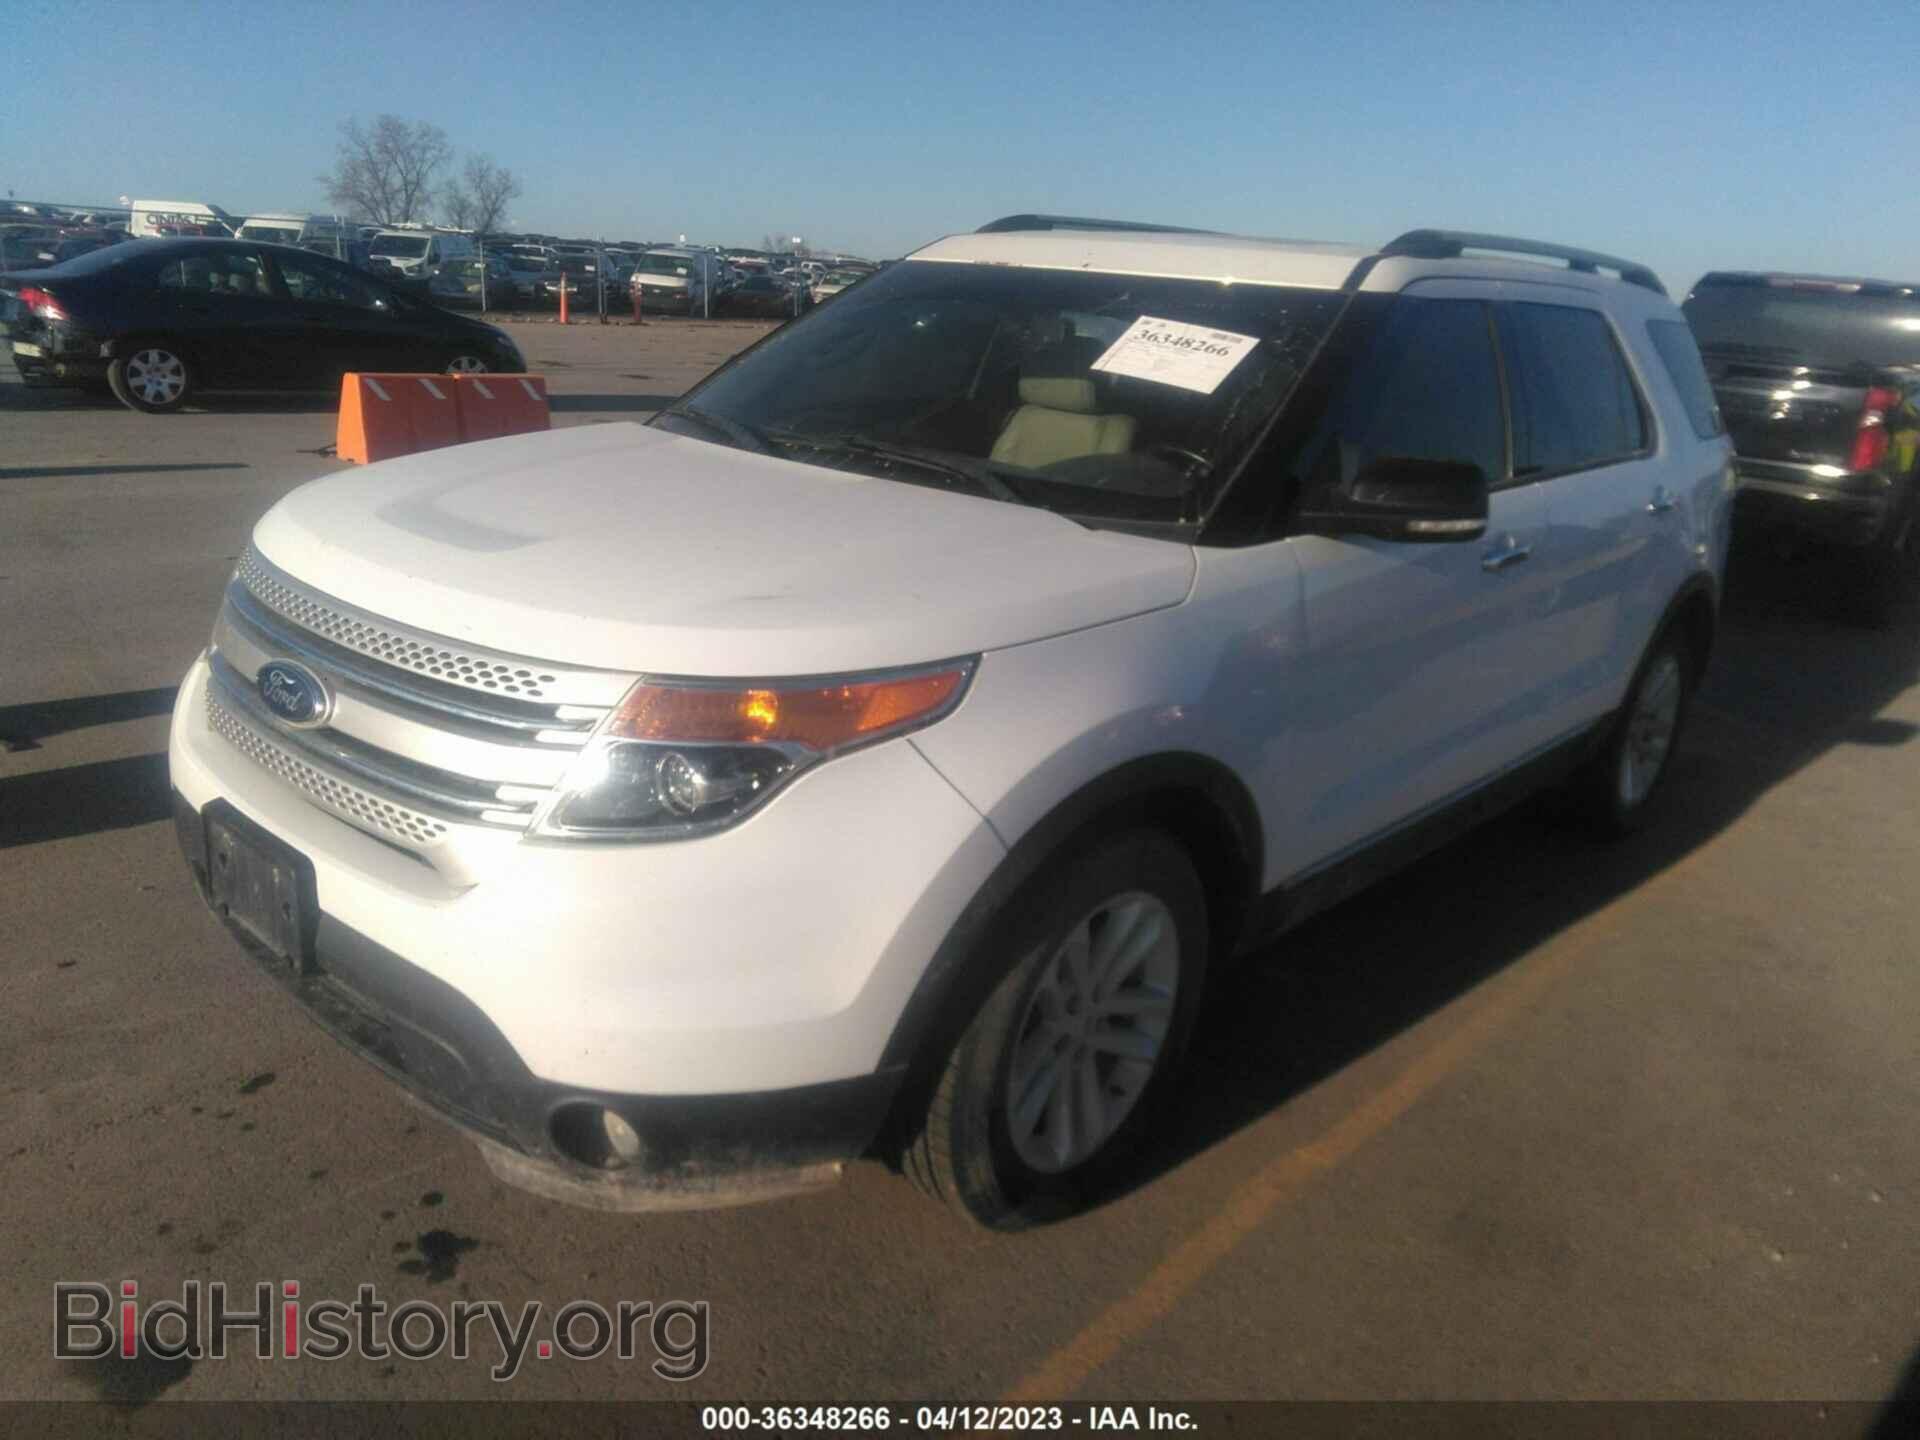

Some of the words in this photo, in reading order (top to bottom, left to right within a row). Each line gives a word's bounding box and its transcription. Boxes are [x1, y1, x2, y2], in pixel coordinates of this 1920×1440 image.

[146, 213, 193, 225] CINTAS
[1133, 329, 1231, 357] 36348266
[264, 669, 303, 713] Ford
